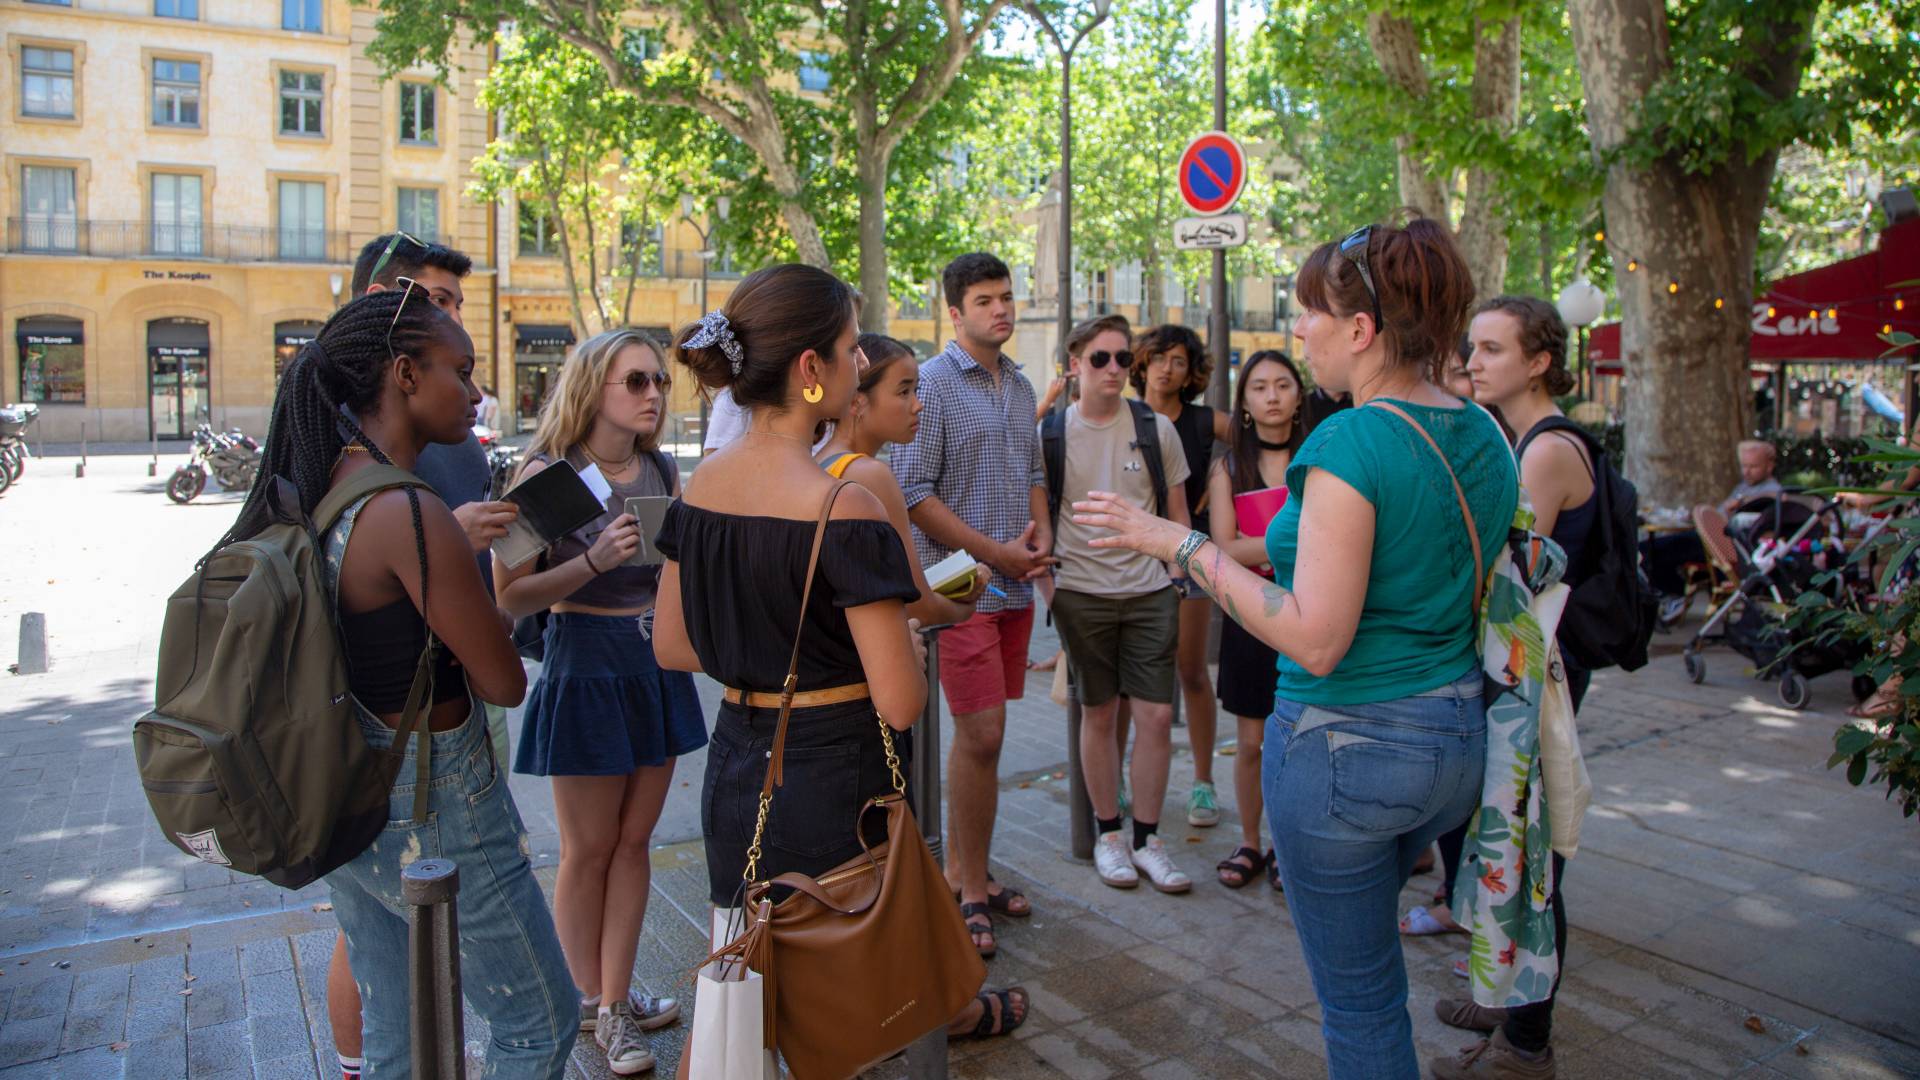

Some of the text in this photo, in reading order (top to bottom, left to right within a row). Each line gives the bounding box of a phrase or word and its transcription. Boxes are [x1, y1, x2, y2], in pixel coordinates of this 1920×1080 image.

[143, 271, 211, 281] The Kooples
[28, 336, 42, 344] The
[158, 347, 172, 355] The
